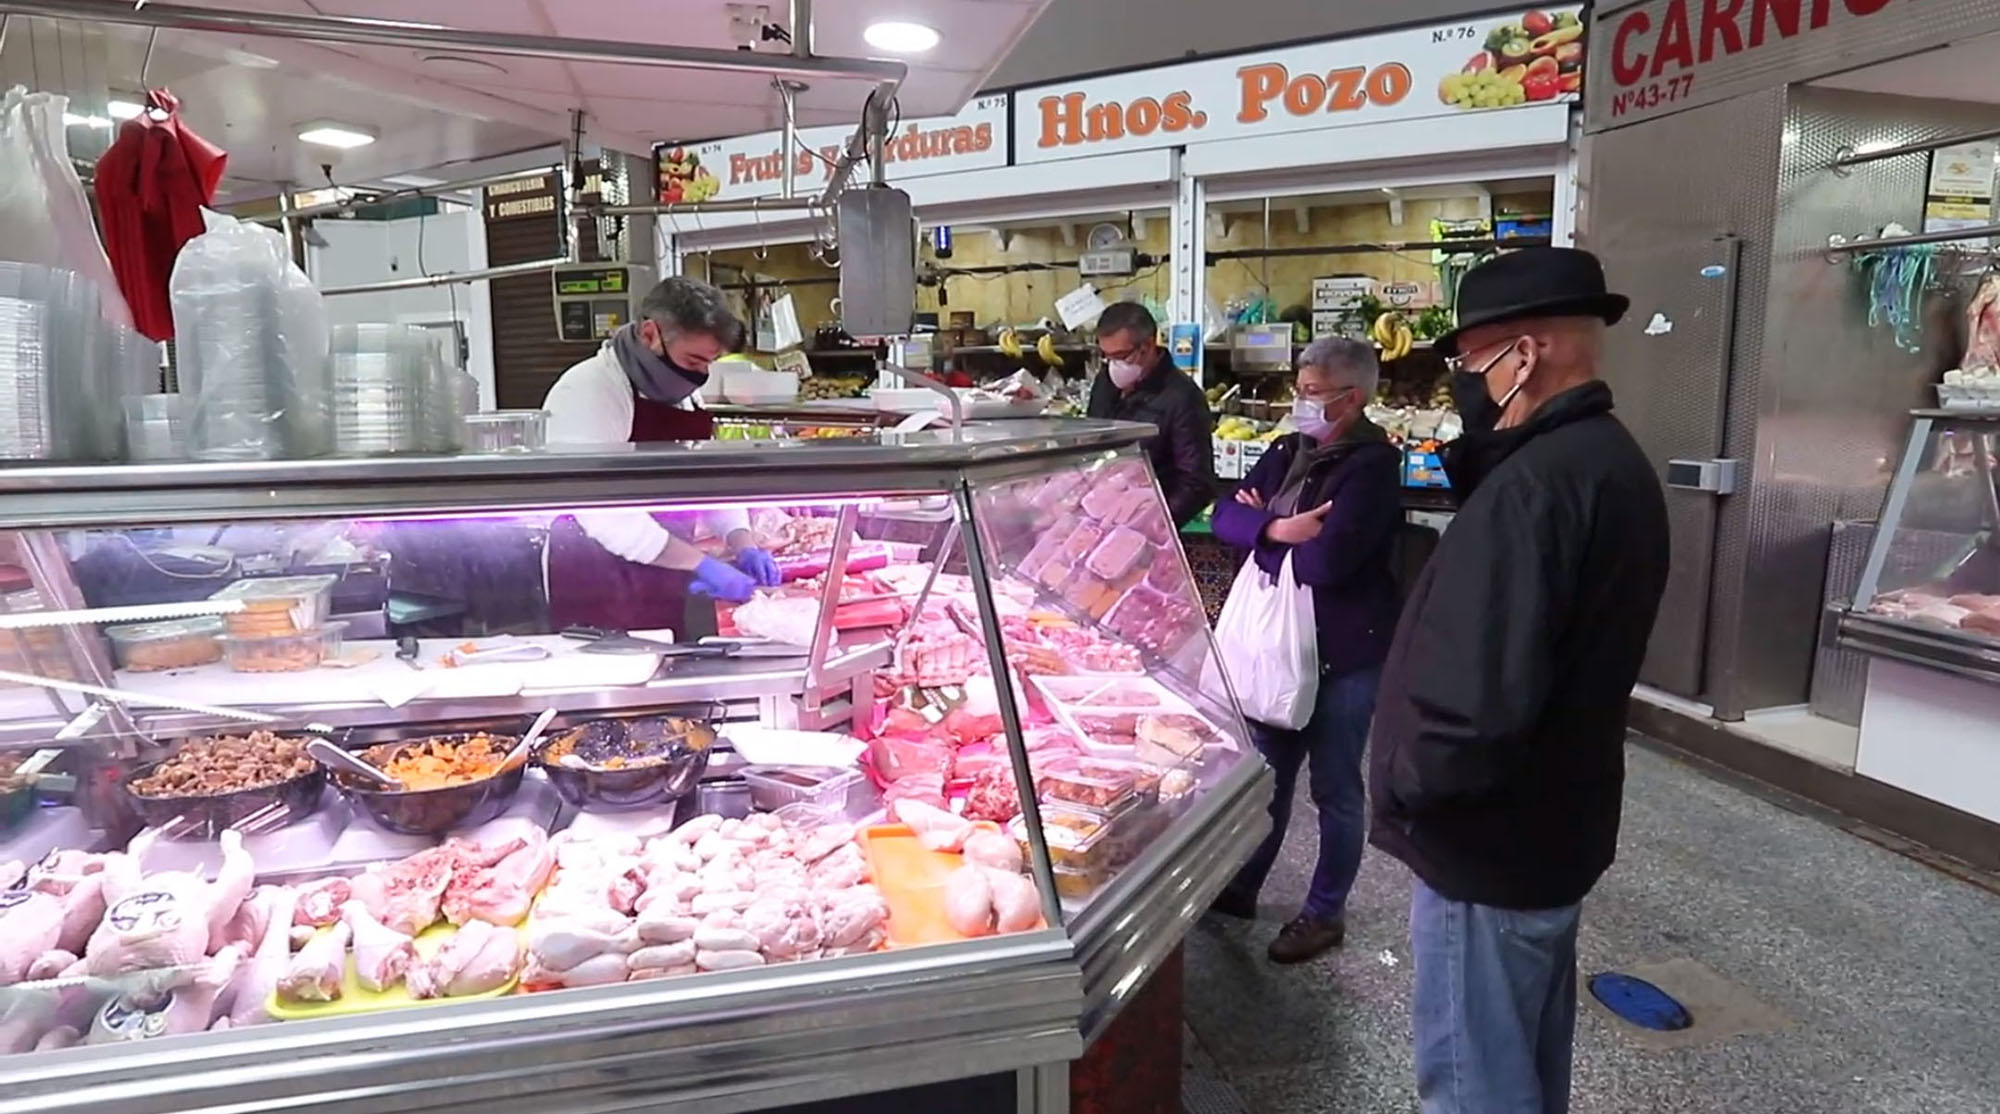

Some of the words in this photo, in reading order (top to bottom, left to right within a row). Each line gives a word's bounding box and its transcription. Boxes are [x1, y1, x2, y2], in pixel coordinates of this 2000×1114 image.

[1457, 26, 1476, 39] 76
[1612, 0, 1894, 86] CARN
[1038, 90, 1207, 148] Hnos.
[1236, 62, 1412, 124] Pozo
[729, 148, 814, 185] Fruts
[845, 122, 993, 163] rduras
